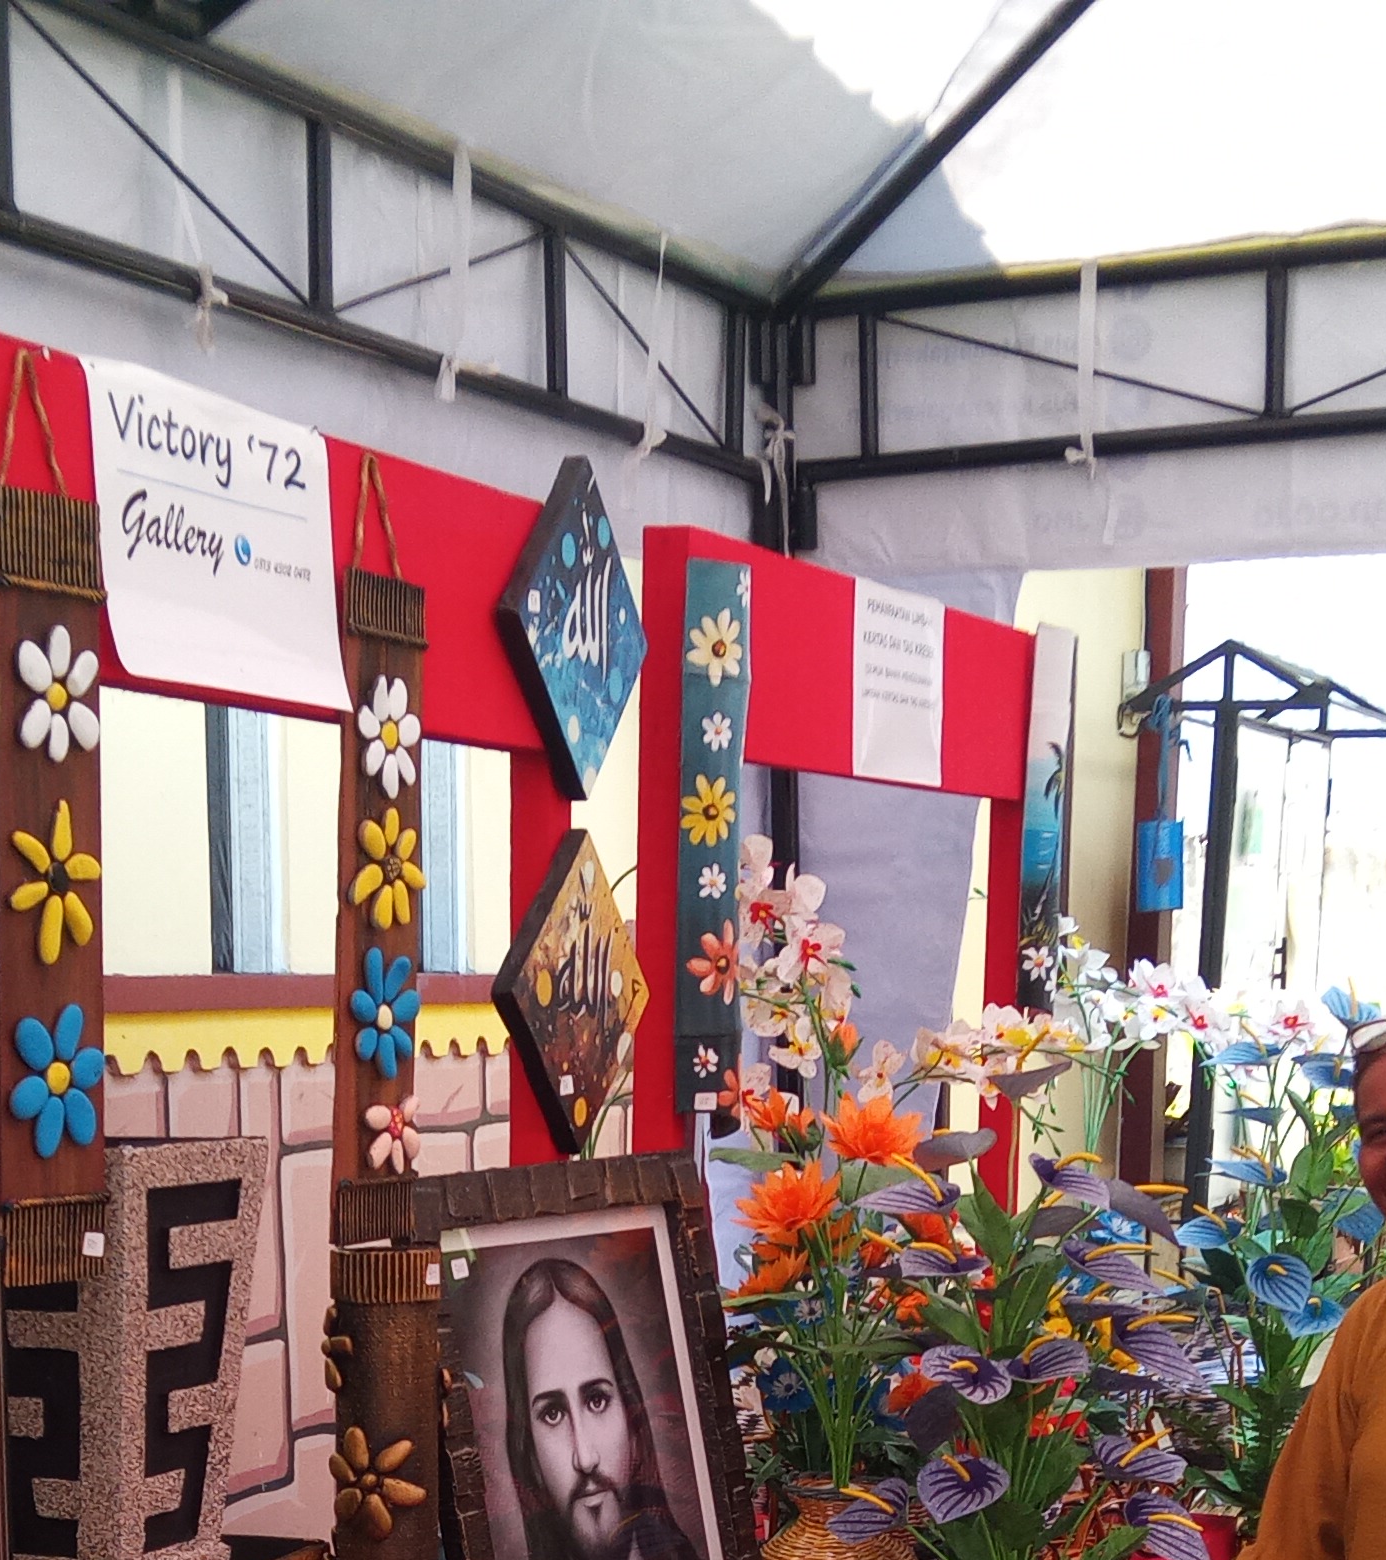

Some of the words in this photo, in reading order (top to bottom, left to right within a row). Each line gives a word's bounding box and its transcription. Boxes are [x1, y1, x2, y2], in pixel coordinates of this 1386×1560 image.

[107, 390, 232, 489] Victory
[247, 433, 307, 491] '72
[121, 488, 224, 577] Gallery
